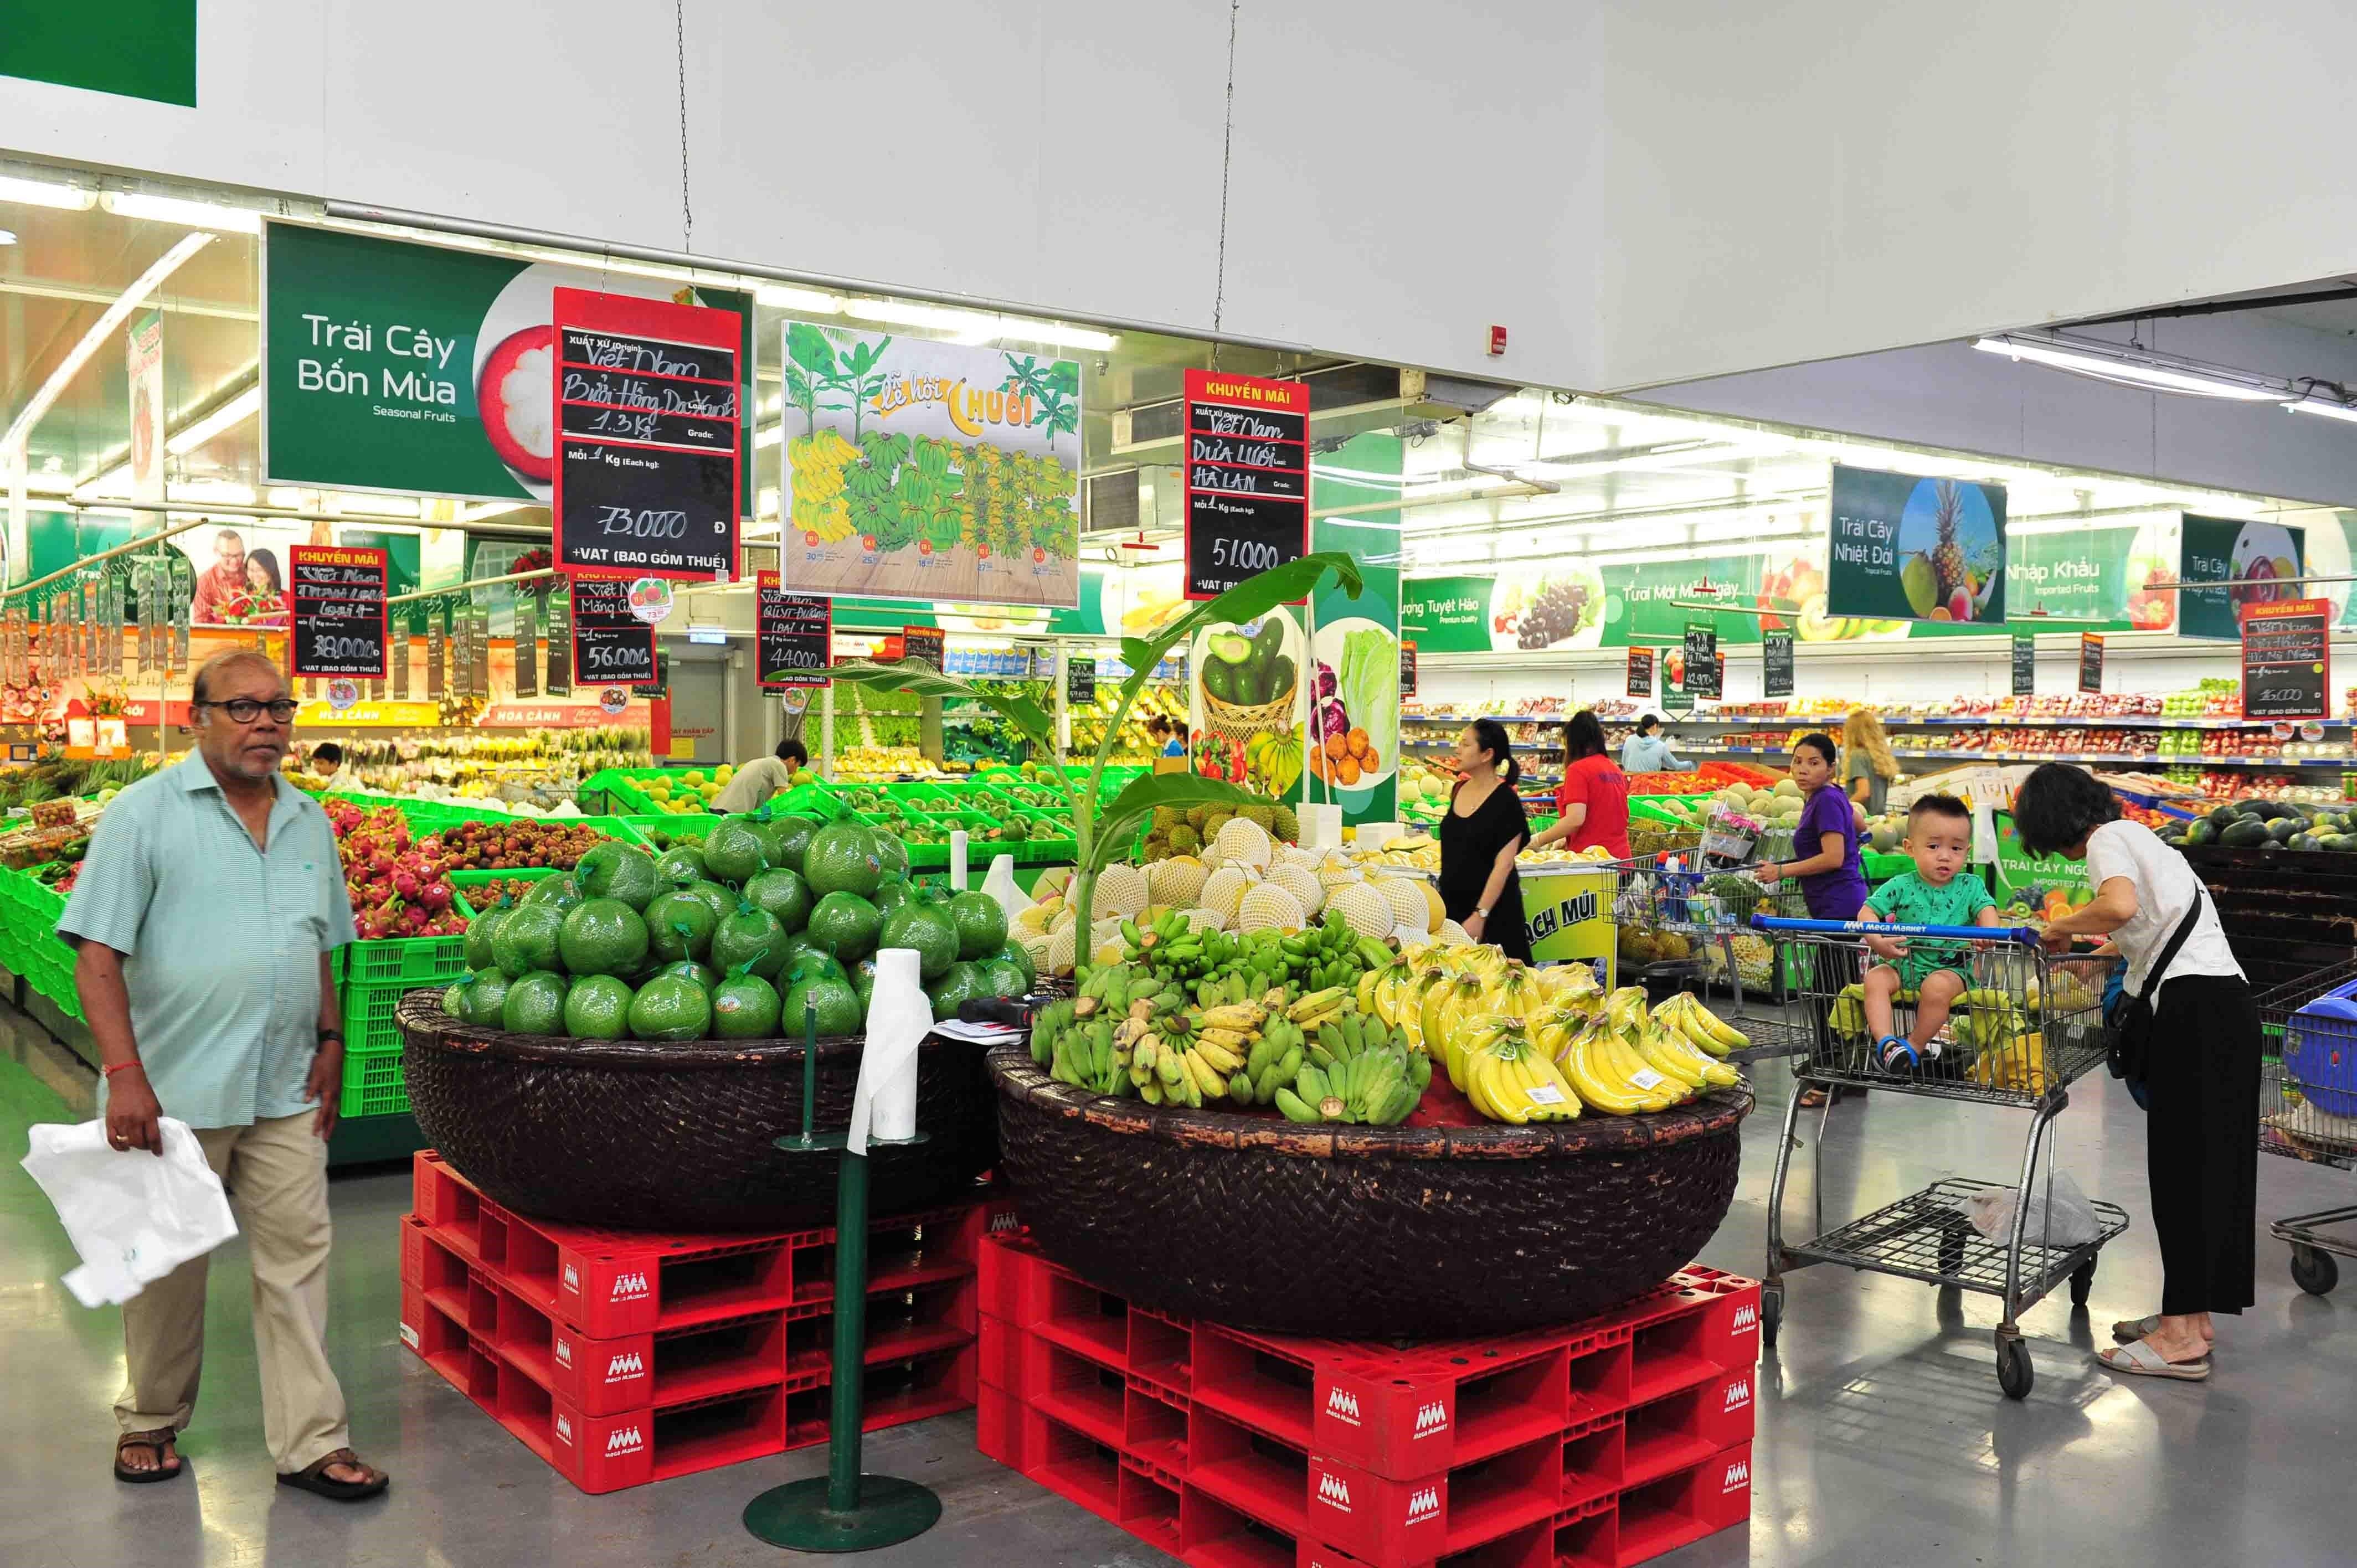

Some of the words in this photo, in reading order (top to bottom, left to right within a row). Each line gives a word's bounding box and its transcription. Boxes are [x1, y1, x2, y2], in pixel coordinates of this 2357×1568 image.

[302, 314, 371, 352] Trái
[387, 325, 456, 369] Cây
[585, 344, 629, 372] Việt
[633, 350, 699, 377] Nam
[299, 358, 368, 396] Bốn
[383, 368, 456, 405] Mùa
[1206, 381, 1261, 400] KHUYẾN
[1265, 388, 1290, 404] MÃI
[373, 405, 421, 419] Seasonal
[424, 411, 456, 422] Fruits
[688, 429, 714, 439] Grade:
[1241, 417, 1284, 439] Nam
[605, 453, 620, 466] Kg
[623, 458, 644, 467] (Each
[1222, 473, 1256, 492] LAN
[1219, 503, 1228, 513] Kg
[714, 522, 726, 534] Đ
[1839, 516, 1865, 537] Trái
[1869, 519, 1893, 545] Cây
[299, 549, 351, 564] KHUYẾN
[354, 553, 379, 565] MÃI
[573, 547, 609, 560] +VAT
[614, 550, 647, 563] (BAO
[651, 549, 682, 565] GỒM
[687, 553, 727, 569] THUẾ)
[1212, 538, 1279, 570] 51.000
[1835, 541, 1868, 566] Nhiệt
[1871, 545, 1893, 565] Đới
[1196, 580, 1220, 591] +VAT
[1427, 598, 1457, 616] Tuyệt
[497, 711, 524, 721] HOA
[2065, 864, 2089, 876] NGO
[1560, 889, 1598, 927] MÚI
